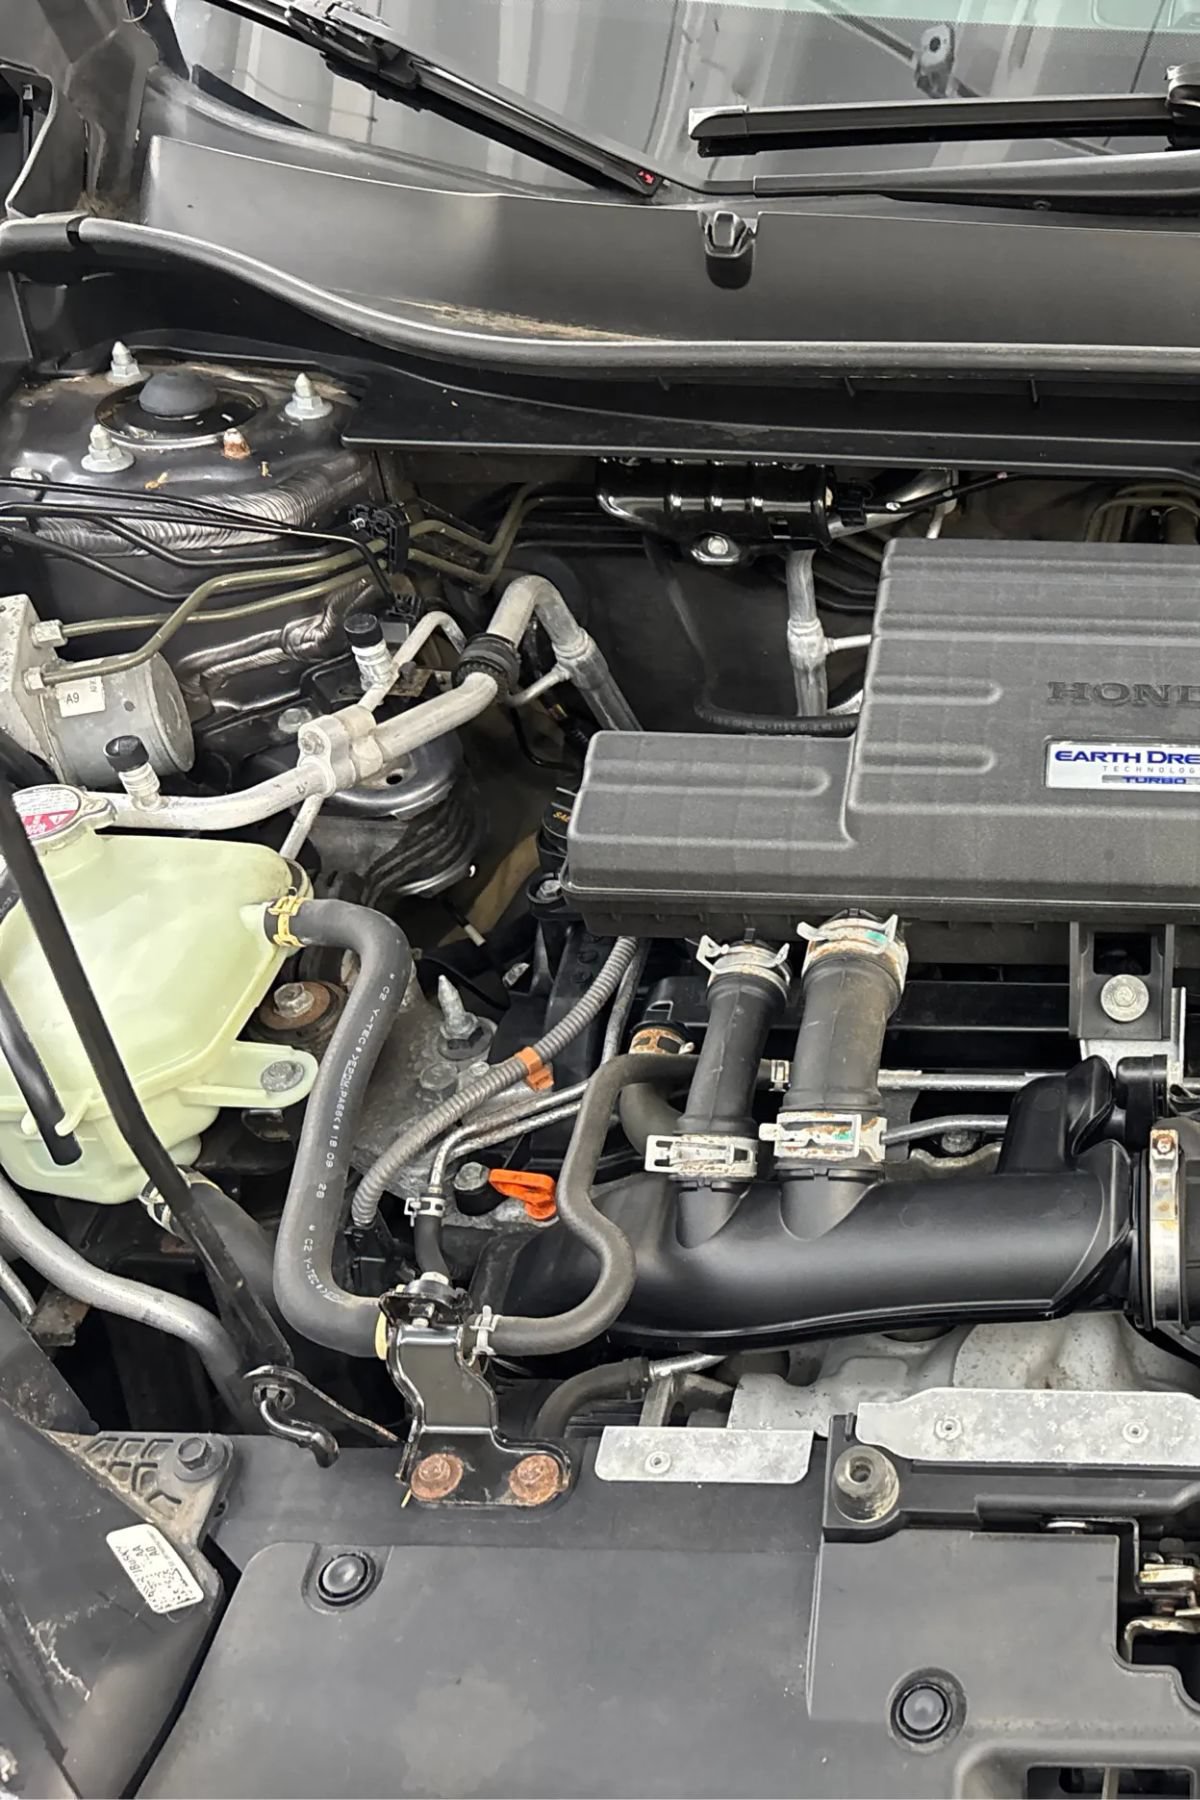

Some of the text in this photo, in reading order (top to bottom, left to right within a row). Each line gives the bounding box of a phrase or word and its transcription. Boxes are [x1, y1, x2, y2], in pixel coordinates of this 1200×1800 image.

[66, 692, 80, 704] A9
[1055, 751, 1141, 763] EARTH
[1122, 776, 1187, 785] TURBO
[378, 985, 390, 1001] C2
[358, 1008, 380, 1045] Y-TEC
[303, 1238, 314, 1252] C2
